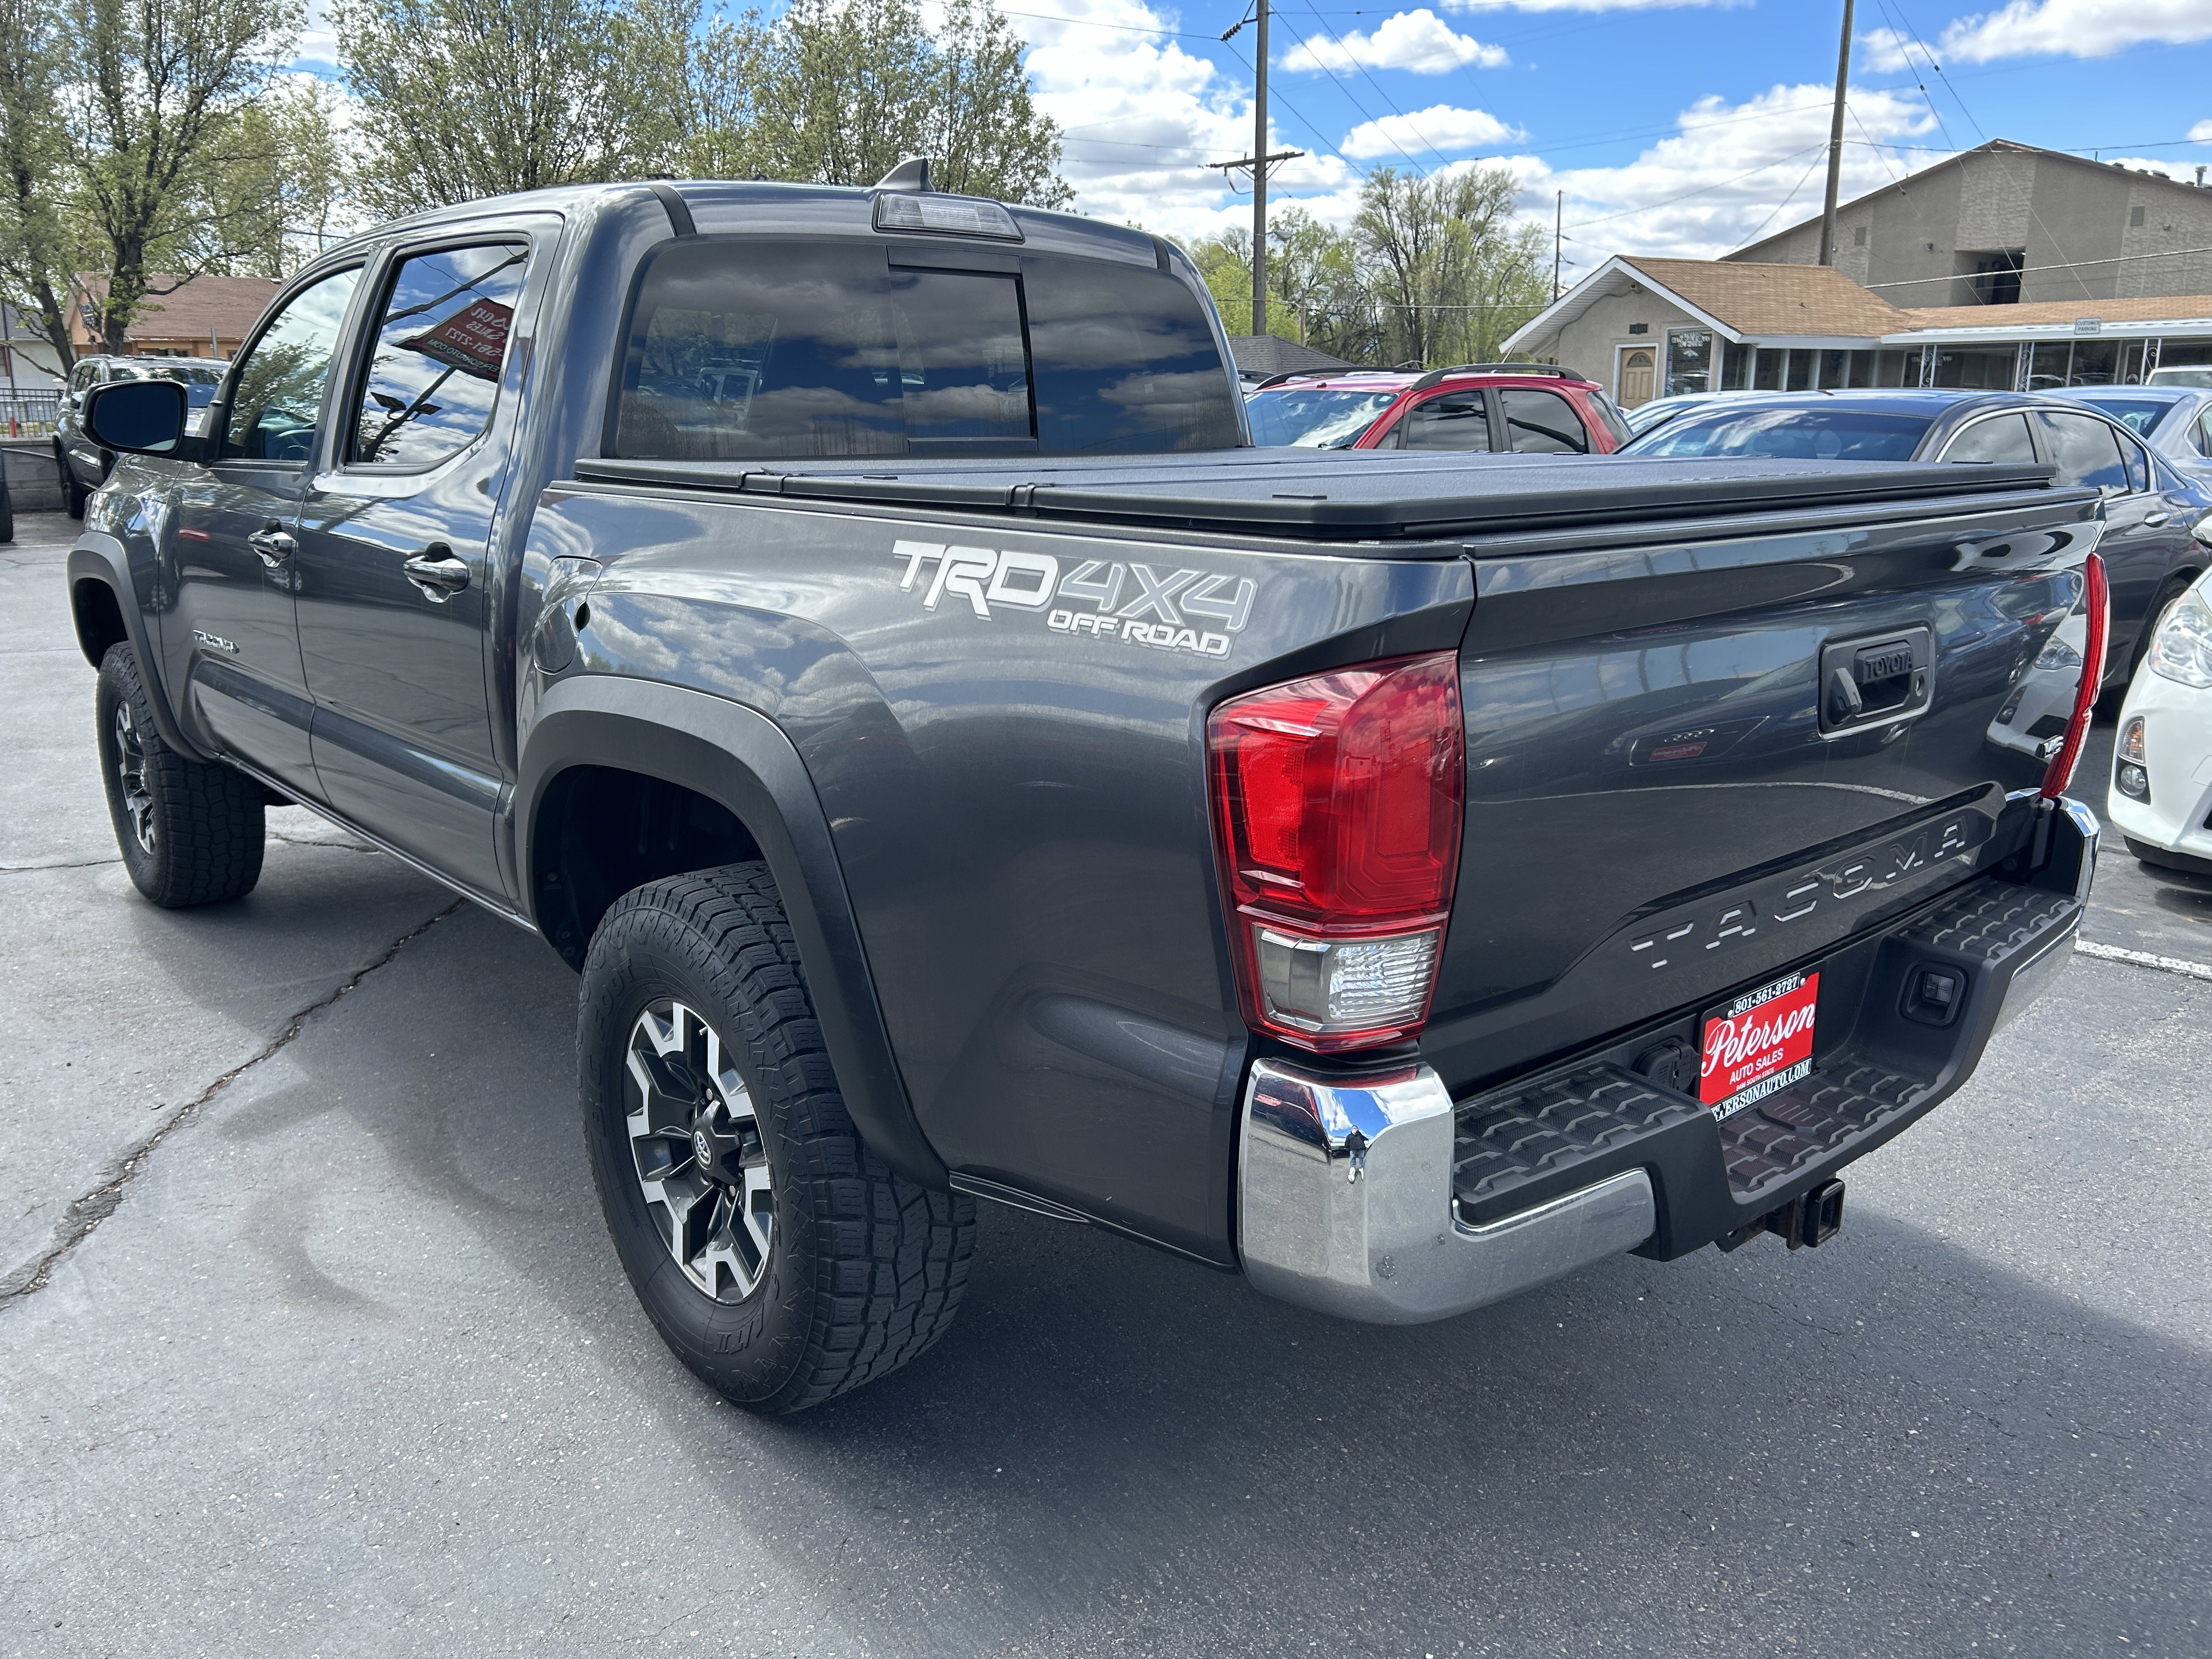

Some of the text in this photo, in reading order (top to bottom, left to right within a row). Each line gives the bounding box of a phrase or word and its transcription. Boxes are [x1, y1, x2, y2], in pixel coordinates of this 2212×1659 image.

[893, 539, 1260, 634] TRD 4X4
[1047, 608, 1231, 659] OFF ROAD
[1865, 650, 1913, 679] TOYOTA
[1629, 815, 1968, 968] TACOMA
[1735, 975, 1798, 1014] 801-561-2727
[1701, 1003, 1816, 1077] Peterson
[1729, 1048, 1784, 1085] AUTO SALES
